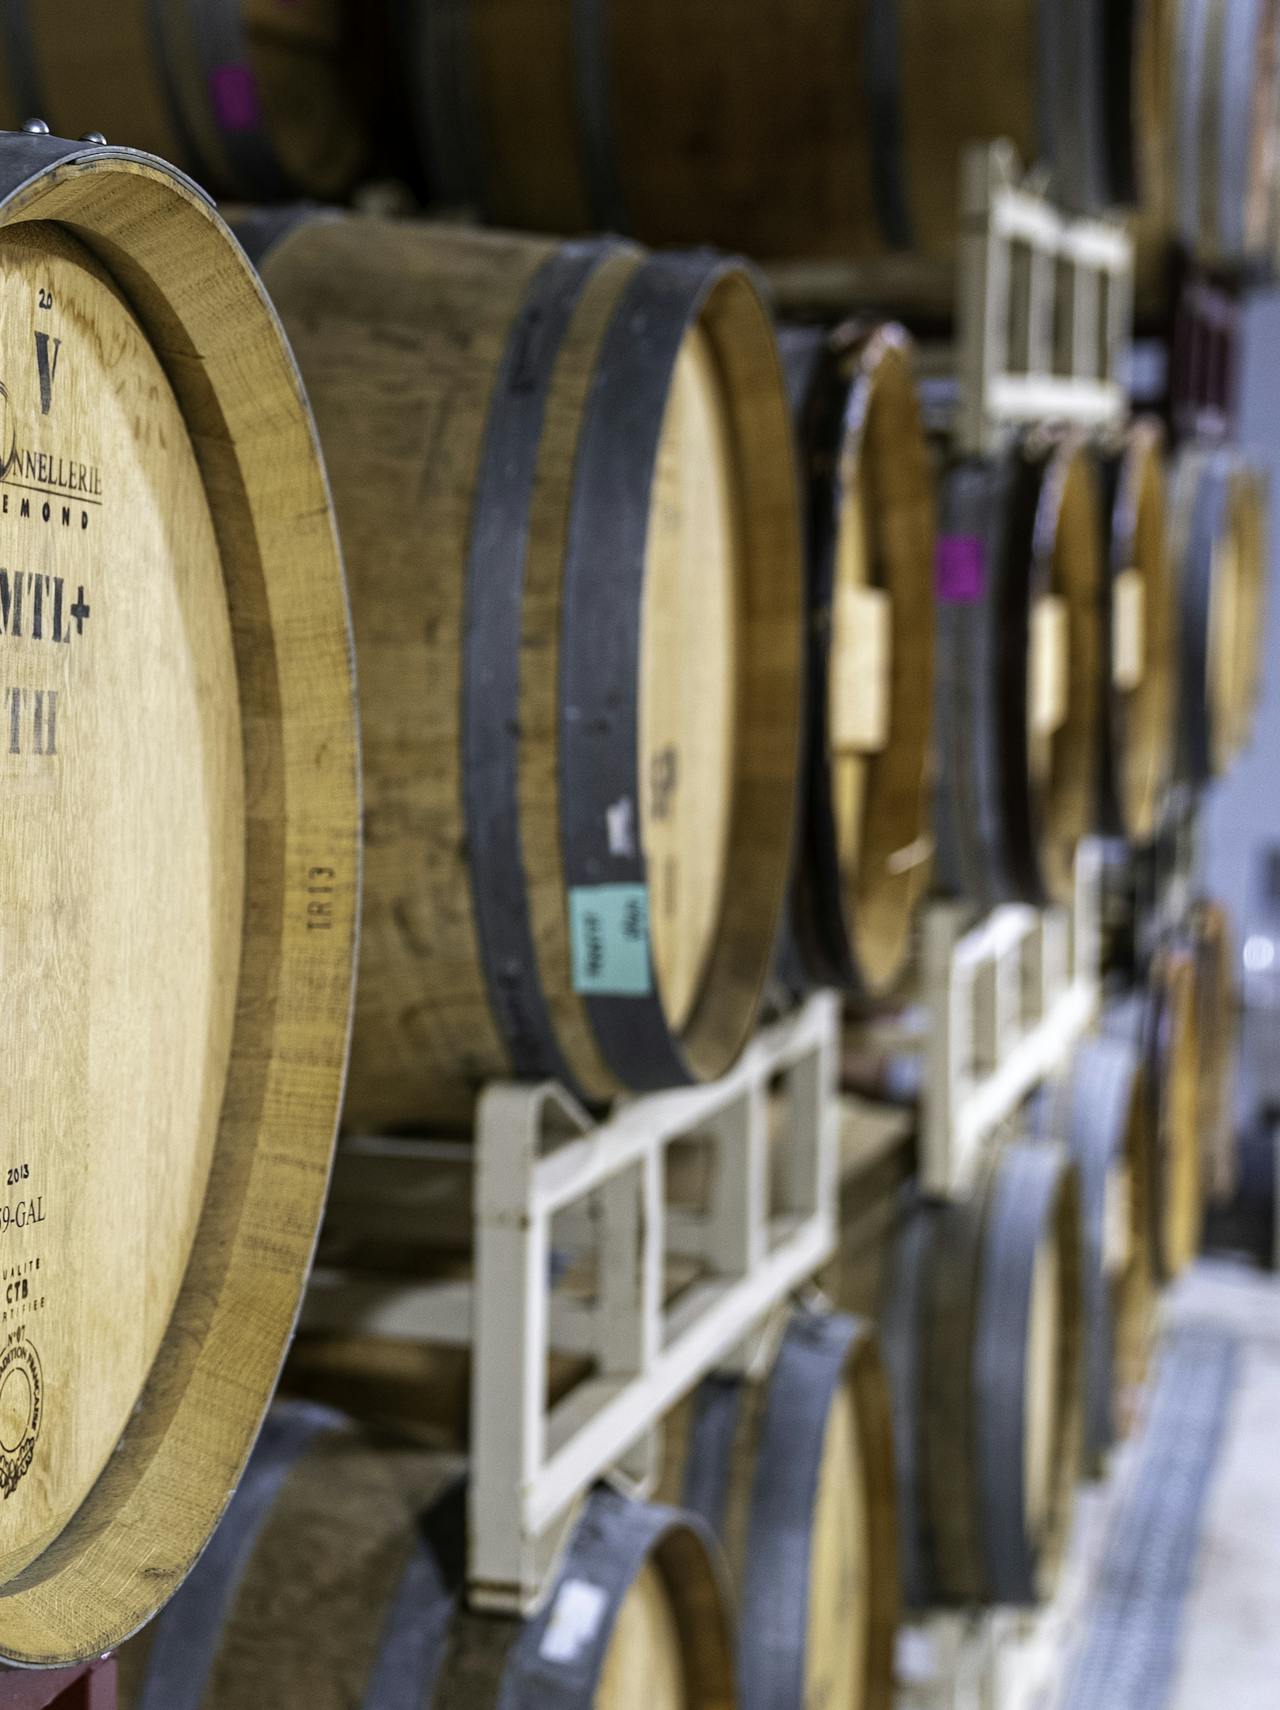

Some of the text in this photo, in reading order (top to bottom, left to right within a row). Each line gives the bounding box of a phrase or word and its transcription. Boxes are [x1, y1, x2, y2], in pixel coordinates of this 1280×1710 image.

[34, 330, 62, 415] V
[7, 1164, 30, 1186] 2013
[6, 1279, 29, 1304] CTB
